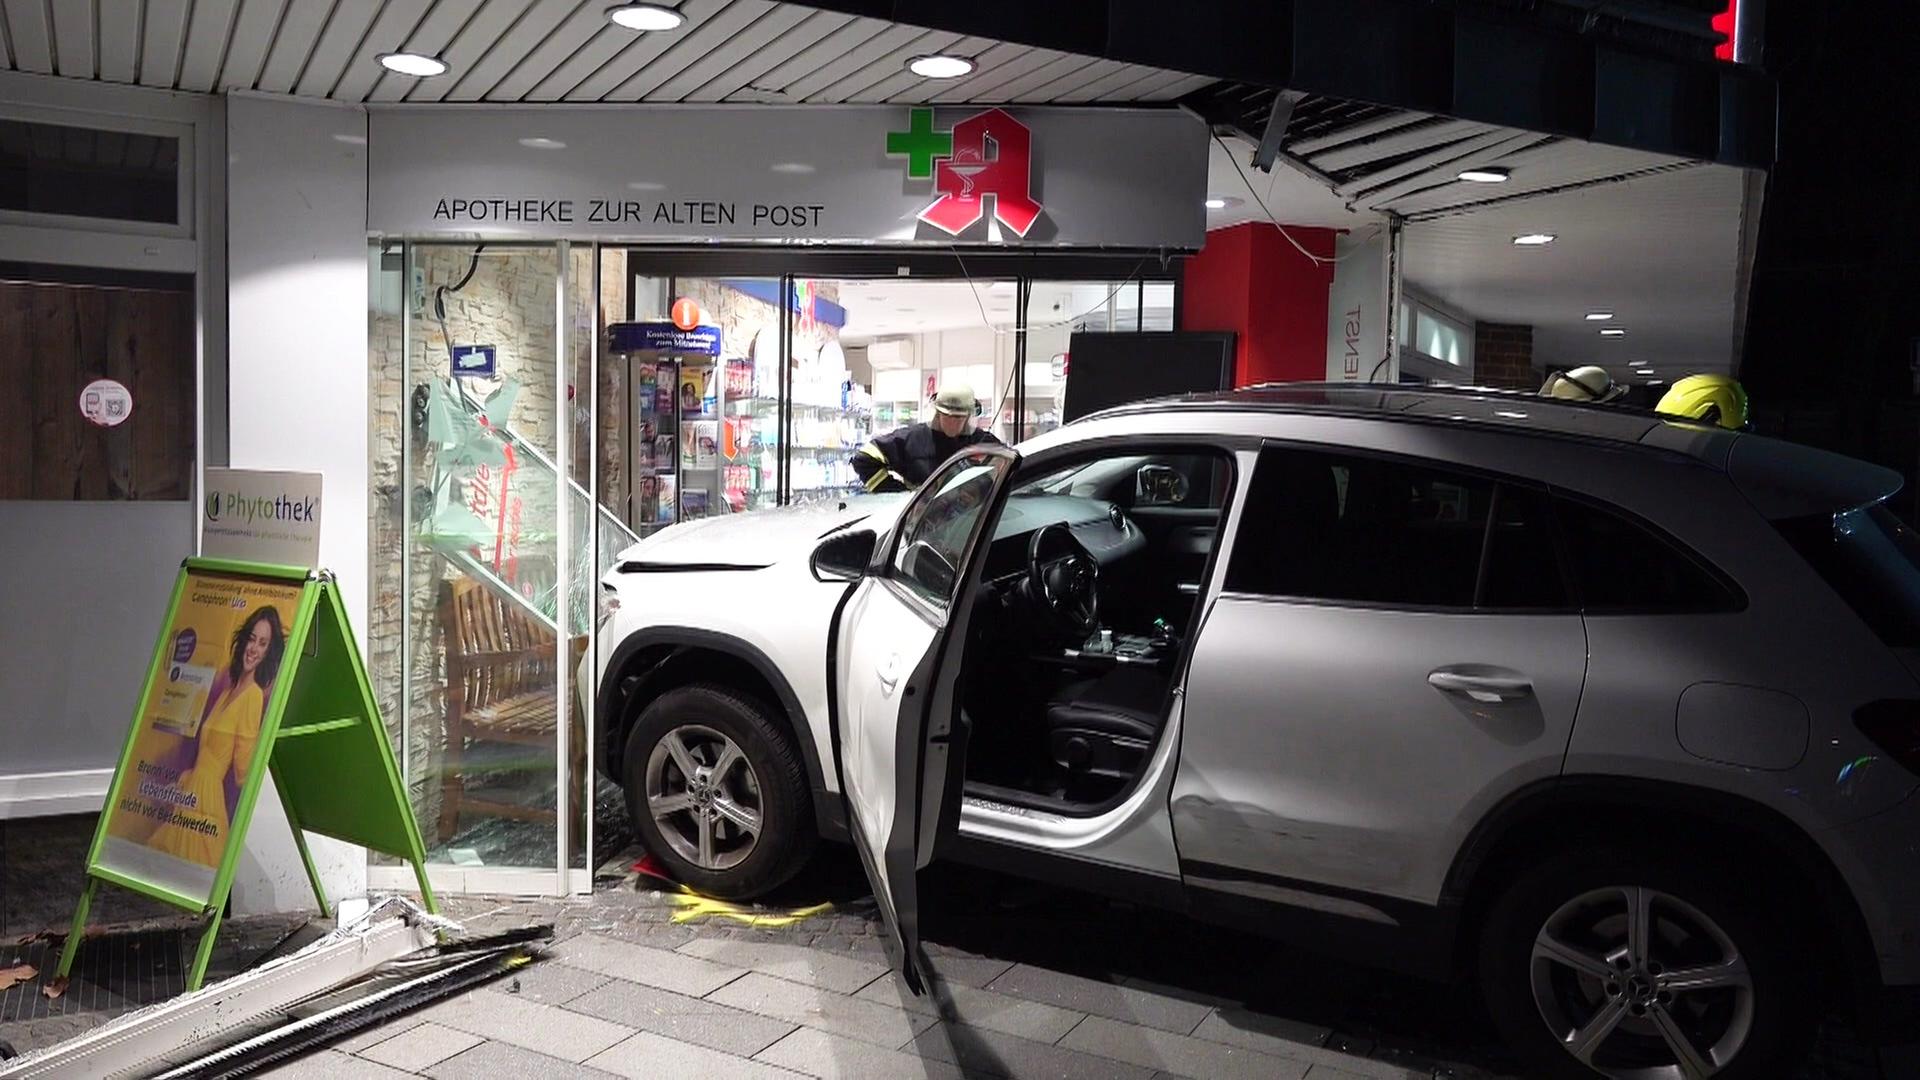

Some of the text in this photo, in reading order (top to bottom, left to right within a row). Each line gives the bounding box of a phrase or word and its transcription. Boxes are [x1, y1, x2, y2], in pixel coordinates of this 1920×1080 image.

[434, 199, 825, 228] APOTHEKE ZUR ALTEN POST
[139, 781, 197, 808] Lebensfreude
[120, 797, 219, 838] nicht vor Beschwerden.
